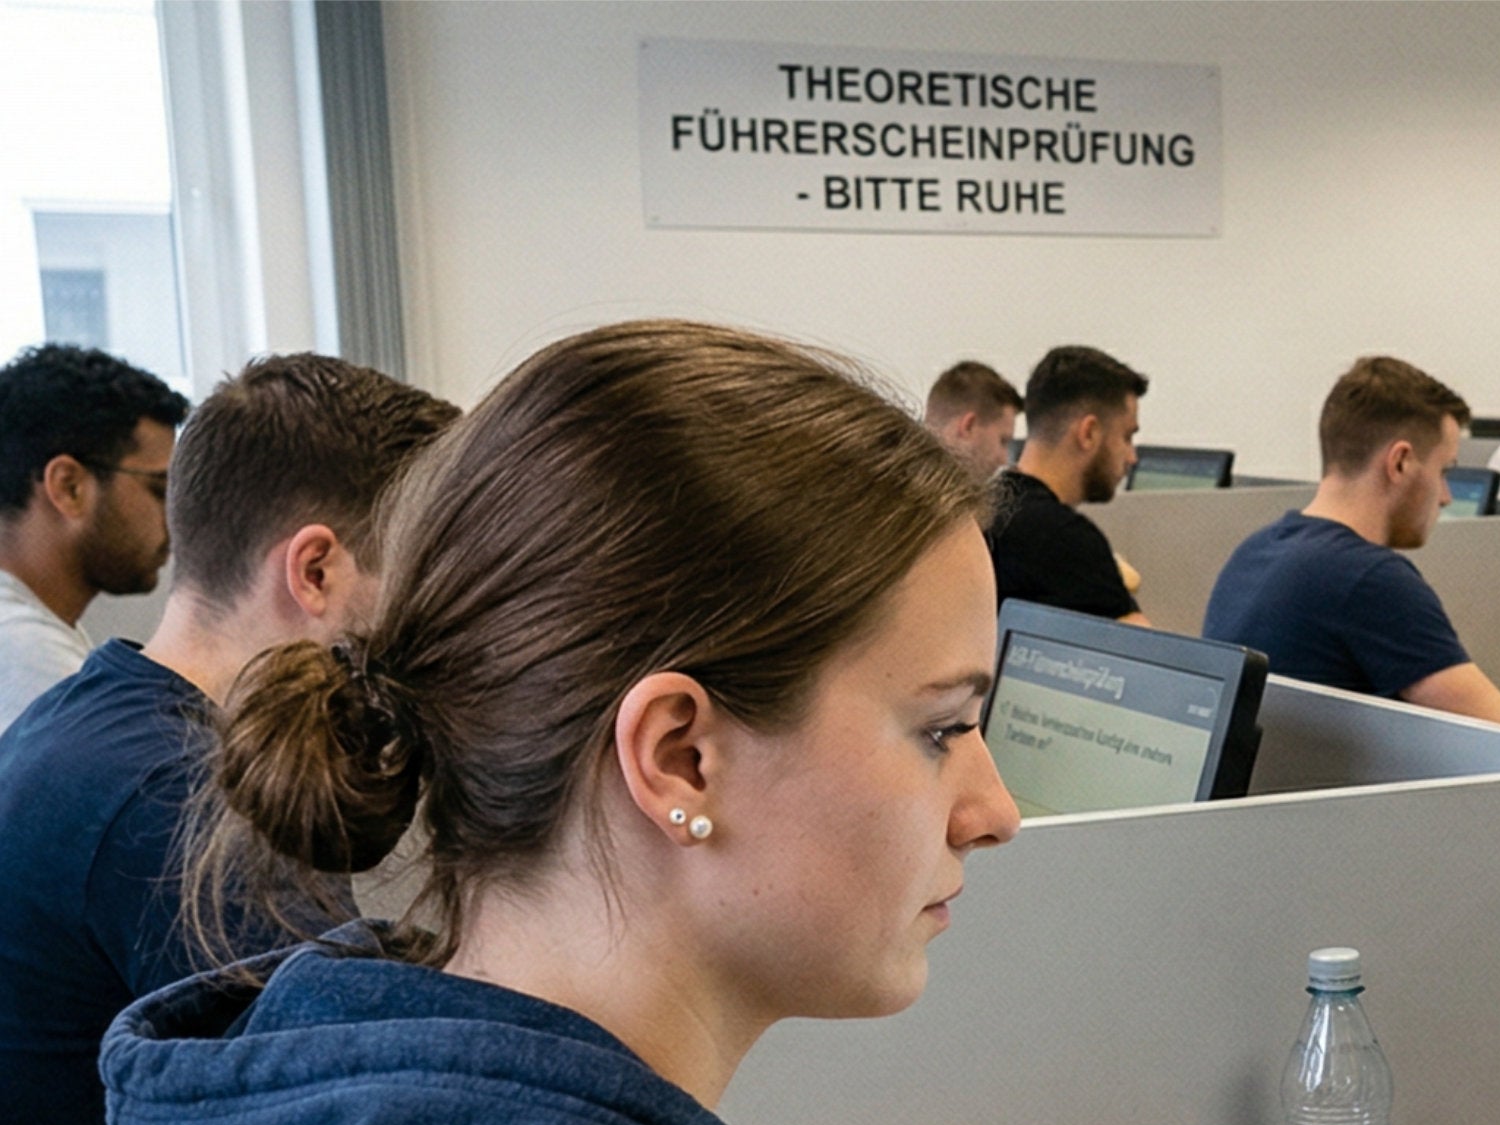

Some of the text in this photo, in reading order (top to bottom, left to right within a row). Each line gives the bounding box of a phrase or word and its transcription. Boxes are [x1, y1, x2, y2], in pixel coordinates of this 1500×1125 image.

[779, 64, 1098, 113] THEORETISCHE
[671, 108, 1195, 167] FÜHRERSCHEINPRÜFUNG
[824, 176, 941, 212] BITTE
[956, 180, 1065, 214] RUHE
